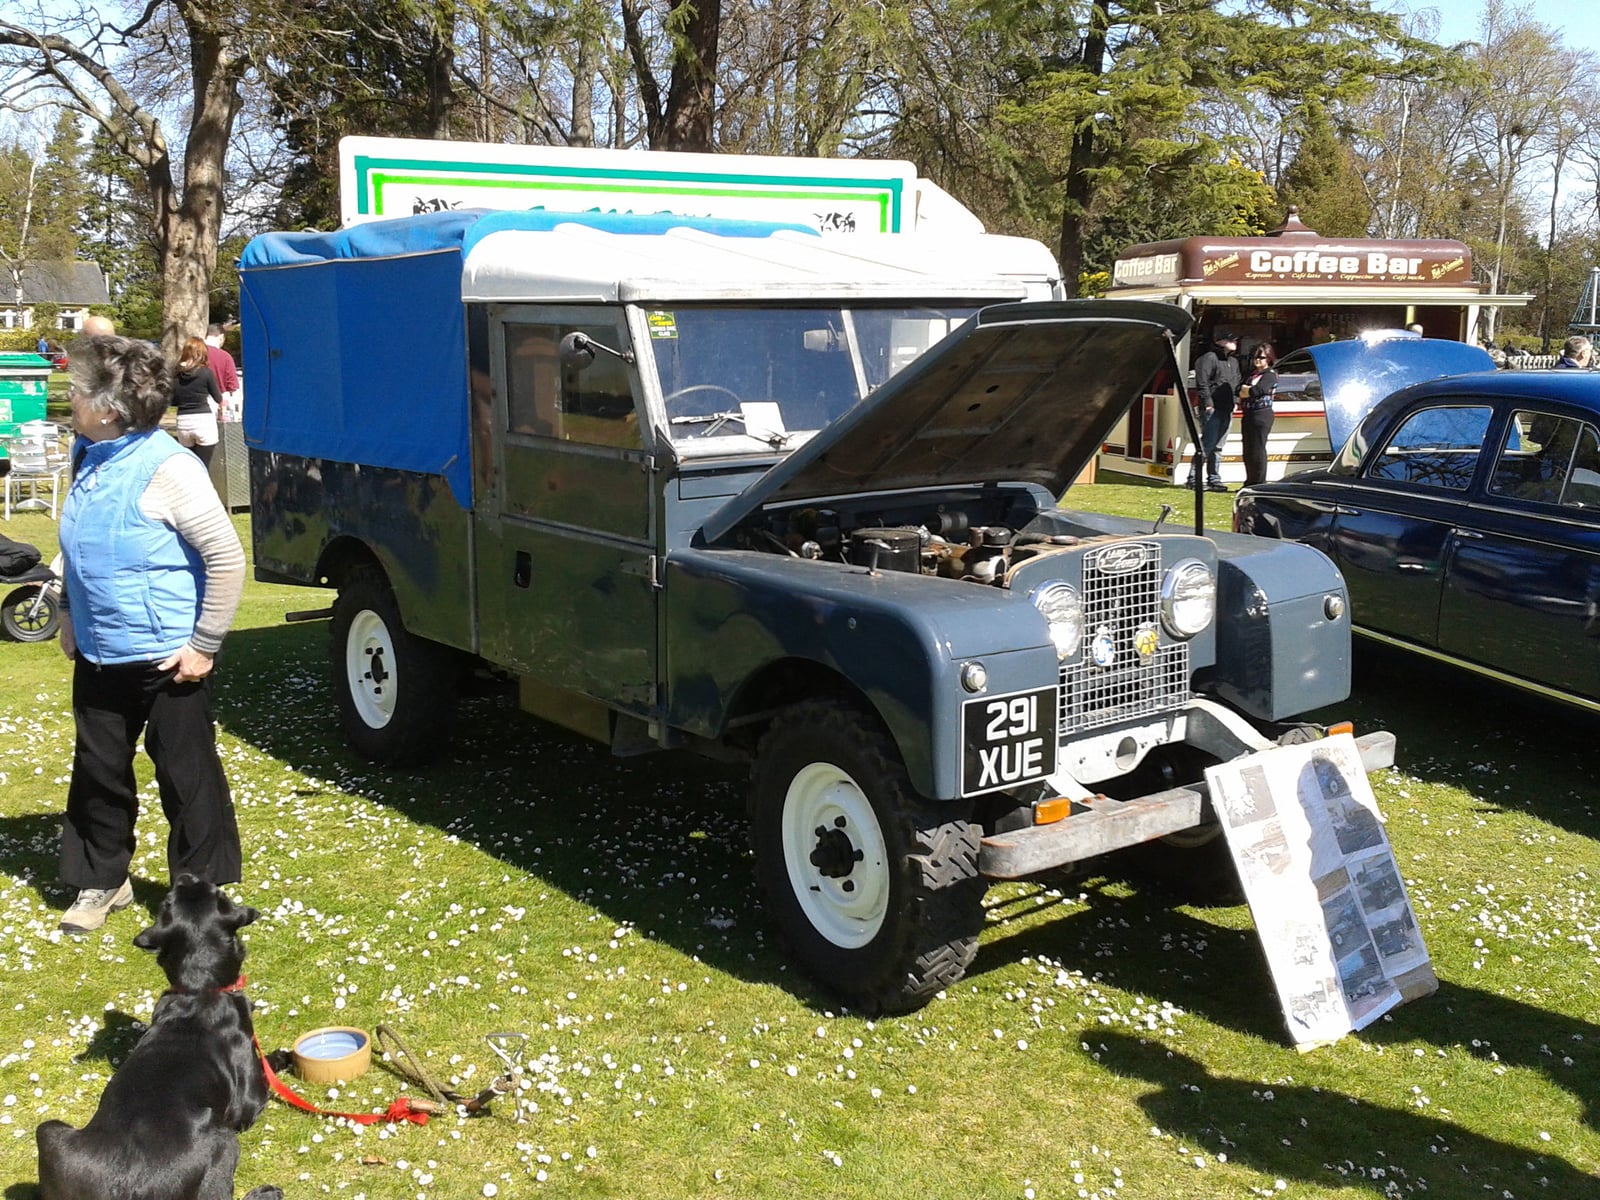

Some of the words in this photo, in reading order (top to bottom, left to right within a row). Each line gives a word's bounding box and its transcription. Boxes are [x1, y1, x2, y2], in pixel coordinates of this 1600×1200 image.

[1115, 257, 1153, 278] Coffee
[1154, 254, 1178, 274] Bar
[1251, 250, 1359, 273] Coffee
[1367, 252, 1423, 275] Bar
[986, 695, 1037, 741] 291
[979, 738, 1043, 787] XUE
